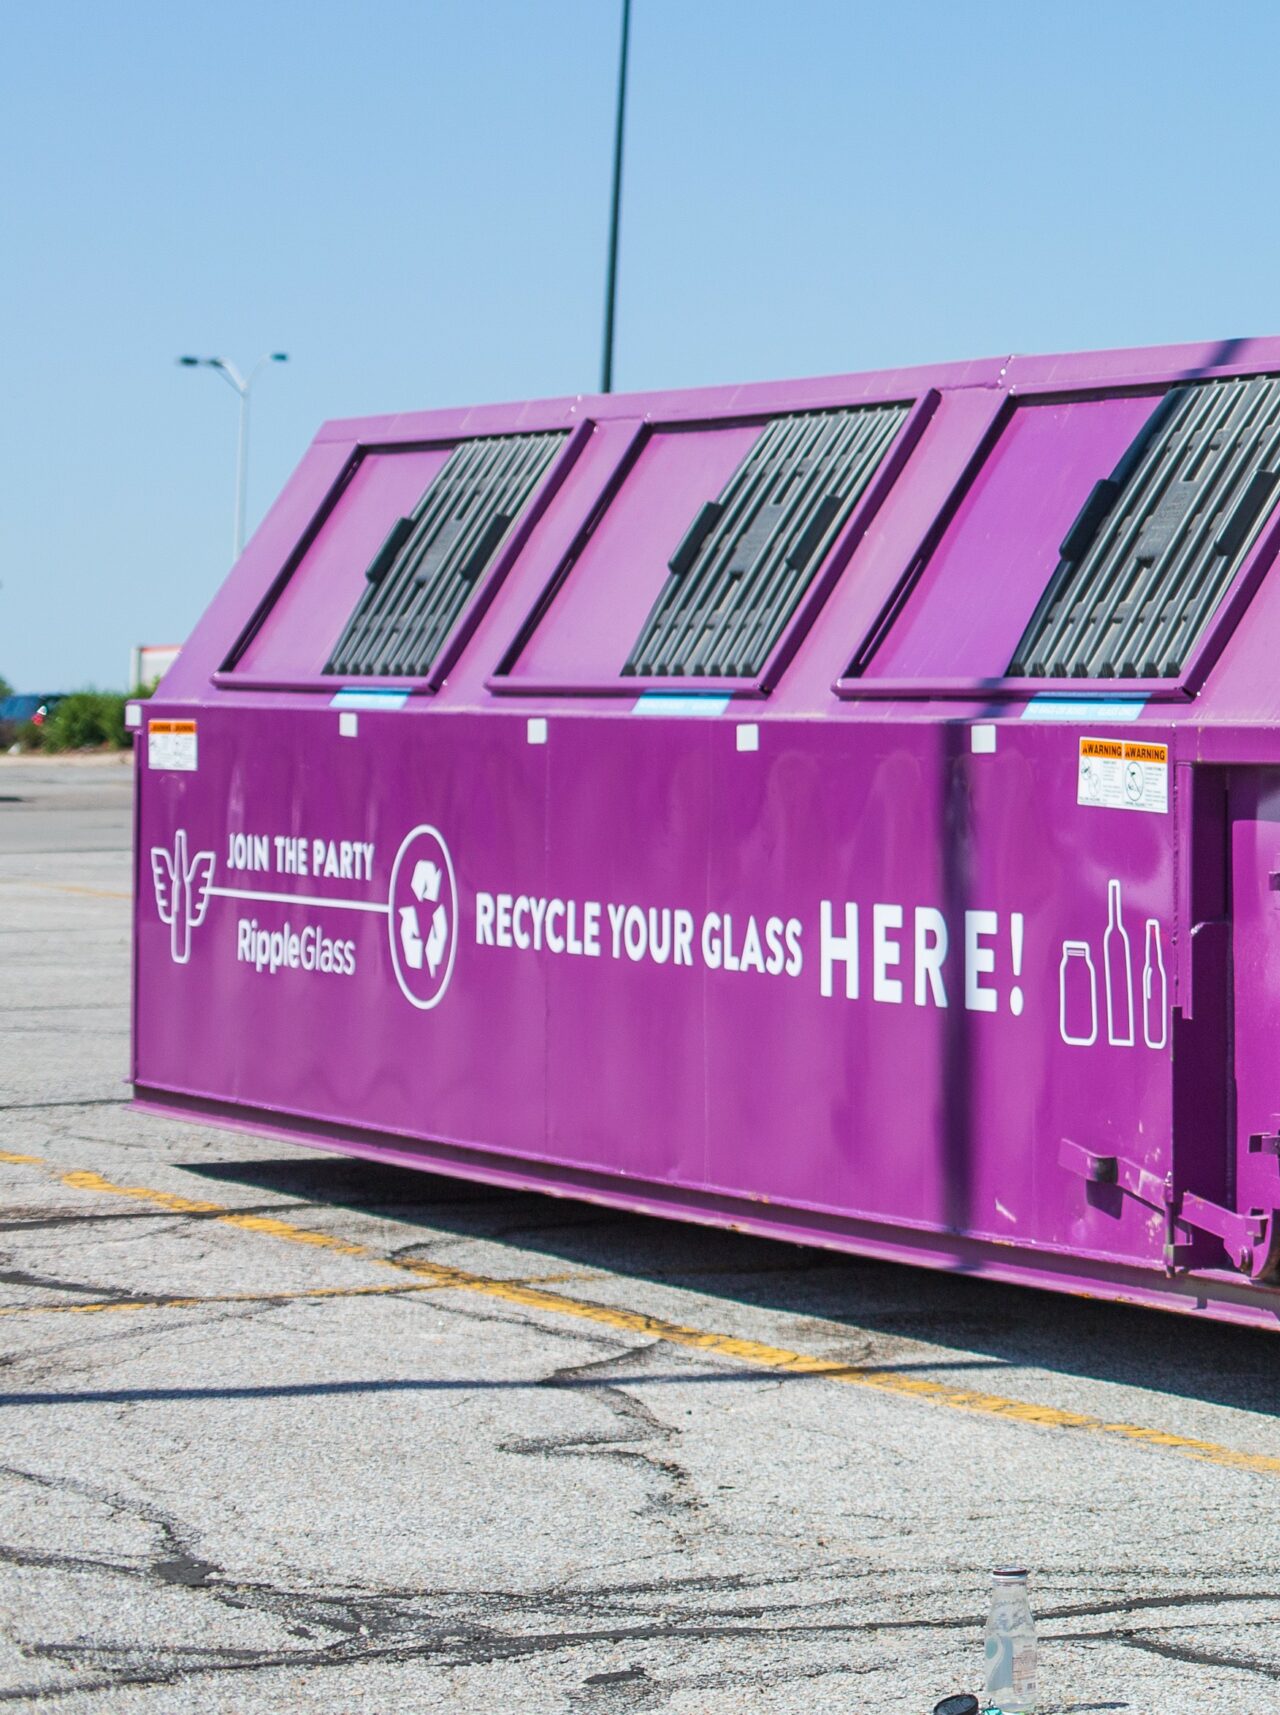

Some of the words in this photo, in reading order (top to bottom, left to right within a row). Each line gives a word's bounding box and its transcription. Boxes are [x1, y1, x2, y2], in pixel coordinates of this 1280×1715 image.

[1087, 745, 1122, 757] WARNING
[1130, 748, 1165, 760] WARNING
[226, 832, 269, 872] JOIN
[274, 836, 308, 876] THE
[312, 839, 375, 881] PARTY
[237, 918, 356, 976] RippleGlass
[475, 892, 601, 957] RECYCLE
[607, 903, 694, 966] YOUR
[701, 911, 803, 977] GLASS
[820, 900, 1024, 1016] HERE!
